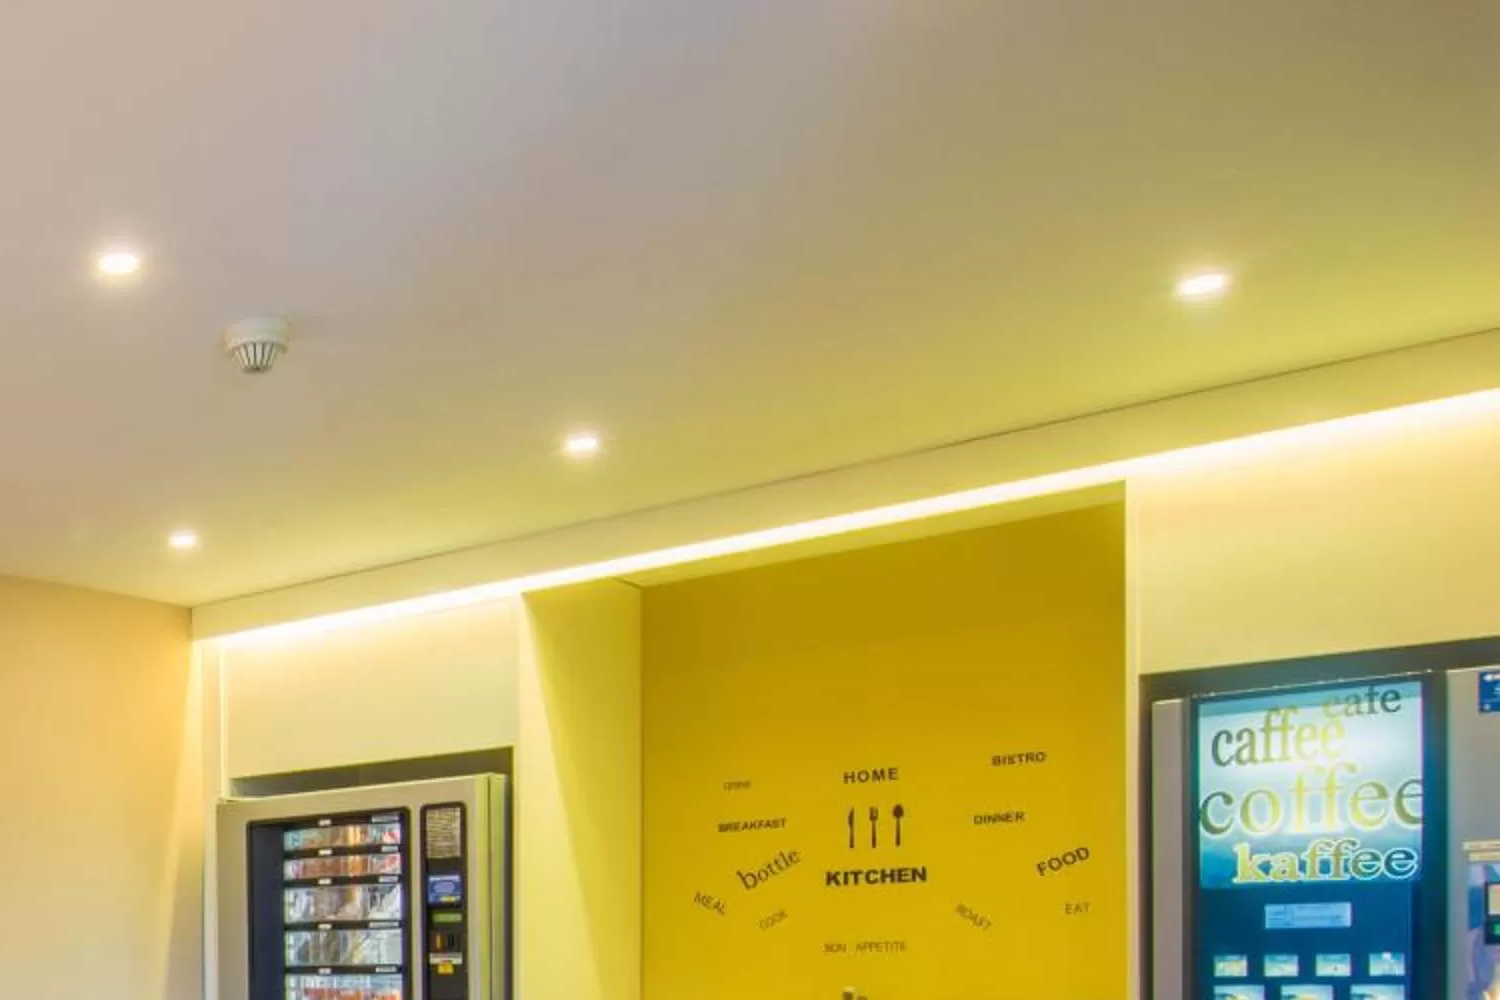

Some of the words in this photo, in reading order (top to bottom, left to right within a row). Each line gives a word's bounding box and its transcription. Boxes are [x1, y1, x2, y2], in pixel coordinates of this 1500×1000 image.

[991, 751, 1048, 768] BISTRO
[843, 767, 900, 785] HOME
[1200, 766, 1423, 836] coffee
[717, 818, 787, 833] BREAKFAST
[973, 810, 1026, 826] DINNER
[1036, 846, 1091, 877] FOOD
[1234, 837, 1420, 882] kaffee
[736, 848, 802, 891] bottle
[825, 866, 928, 887] KITCHEN
[1064, 902, 1091, 915] EAT
